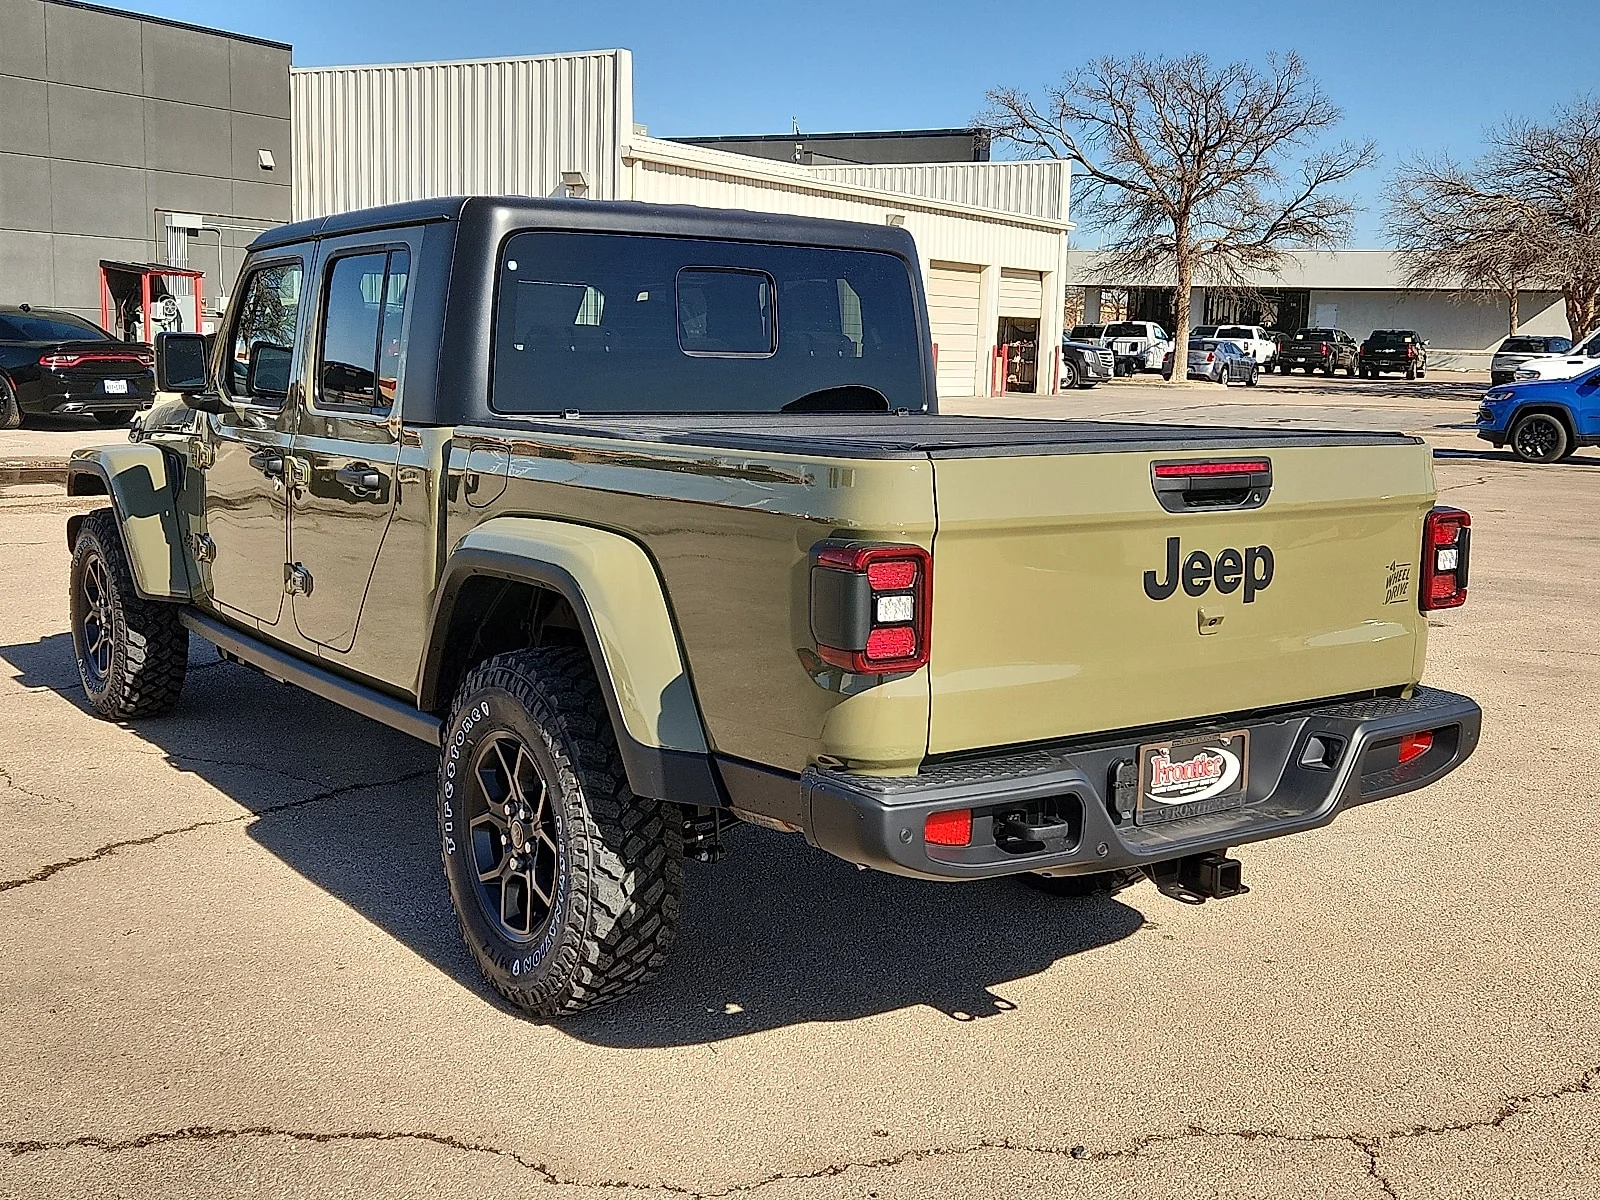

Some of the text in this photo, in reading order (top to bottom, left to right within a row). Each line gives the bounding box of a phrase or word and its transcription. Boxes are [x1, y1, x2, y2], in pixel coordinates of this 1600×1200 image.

[1143, 536, 1274, 603] Jeep
[1385, 569, 1410, 589] WHEEL
[1384, 582, 1409, 605] DRIVE
[1152, 754, 1222, 786] Frontier
[524, 815, 567, 974] DESTINATION
